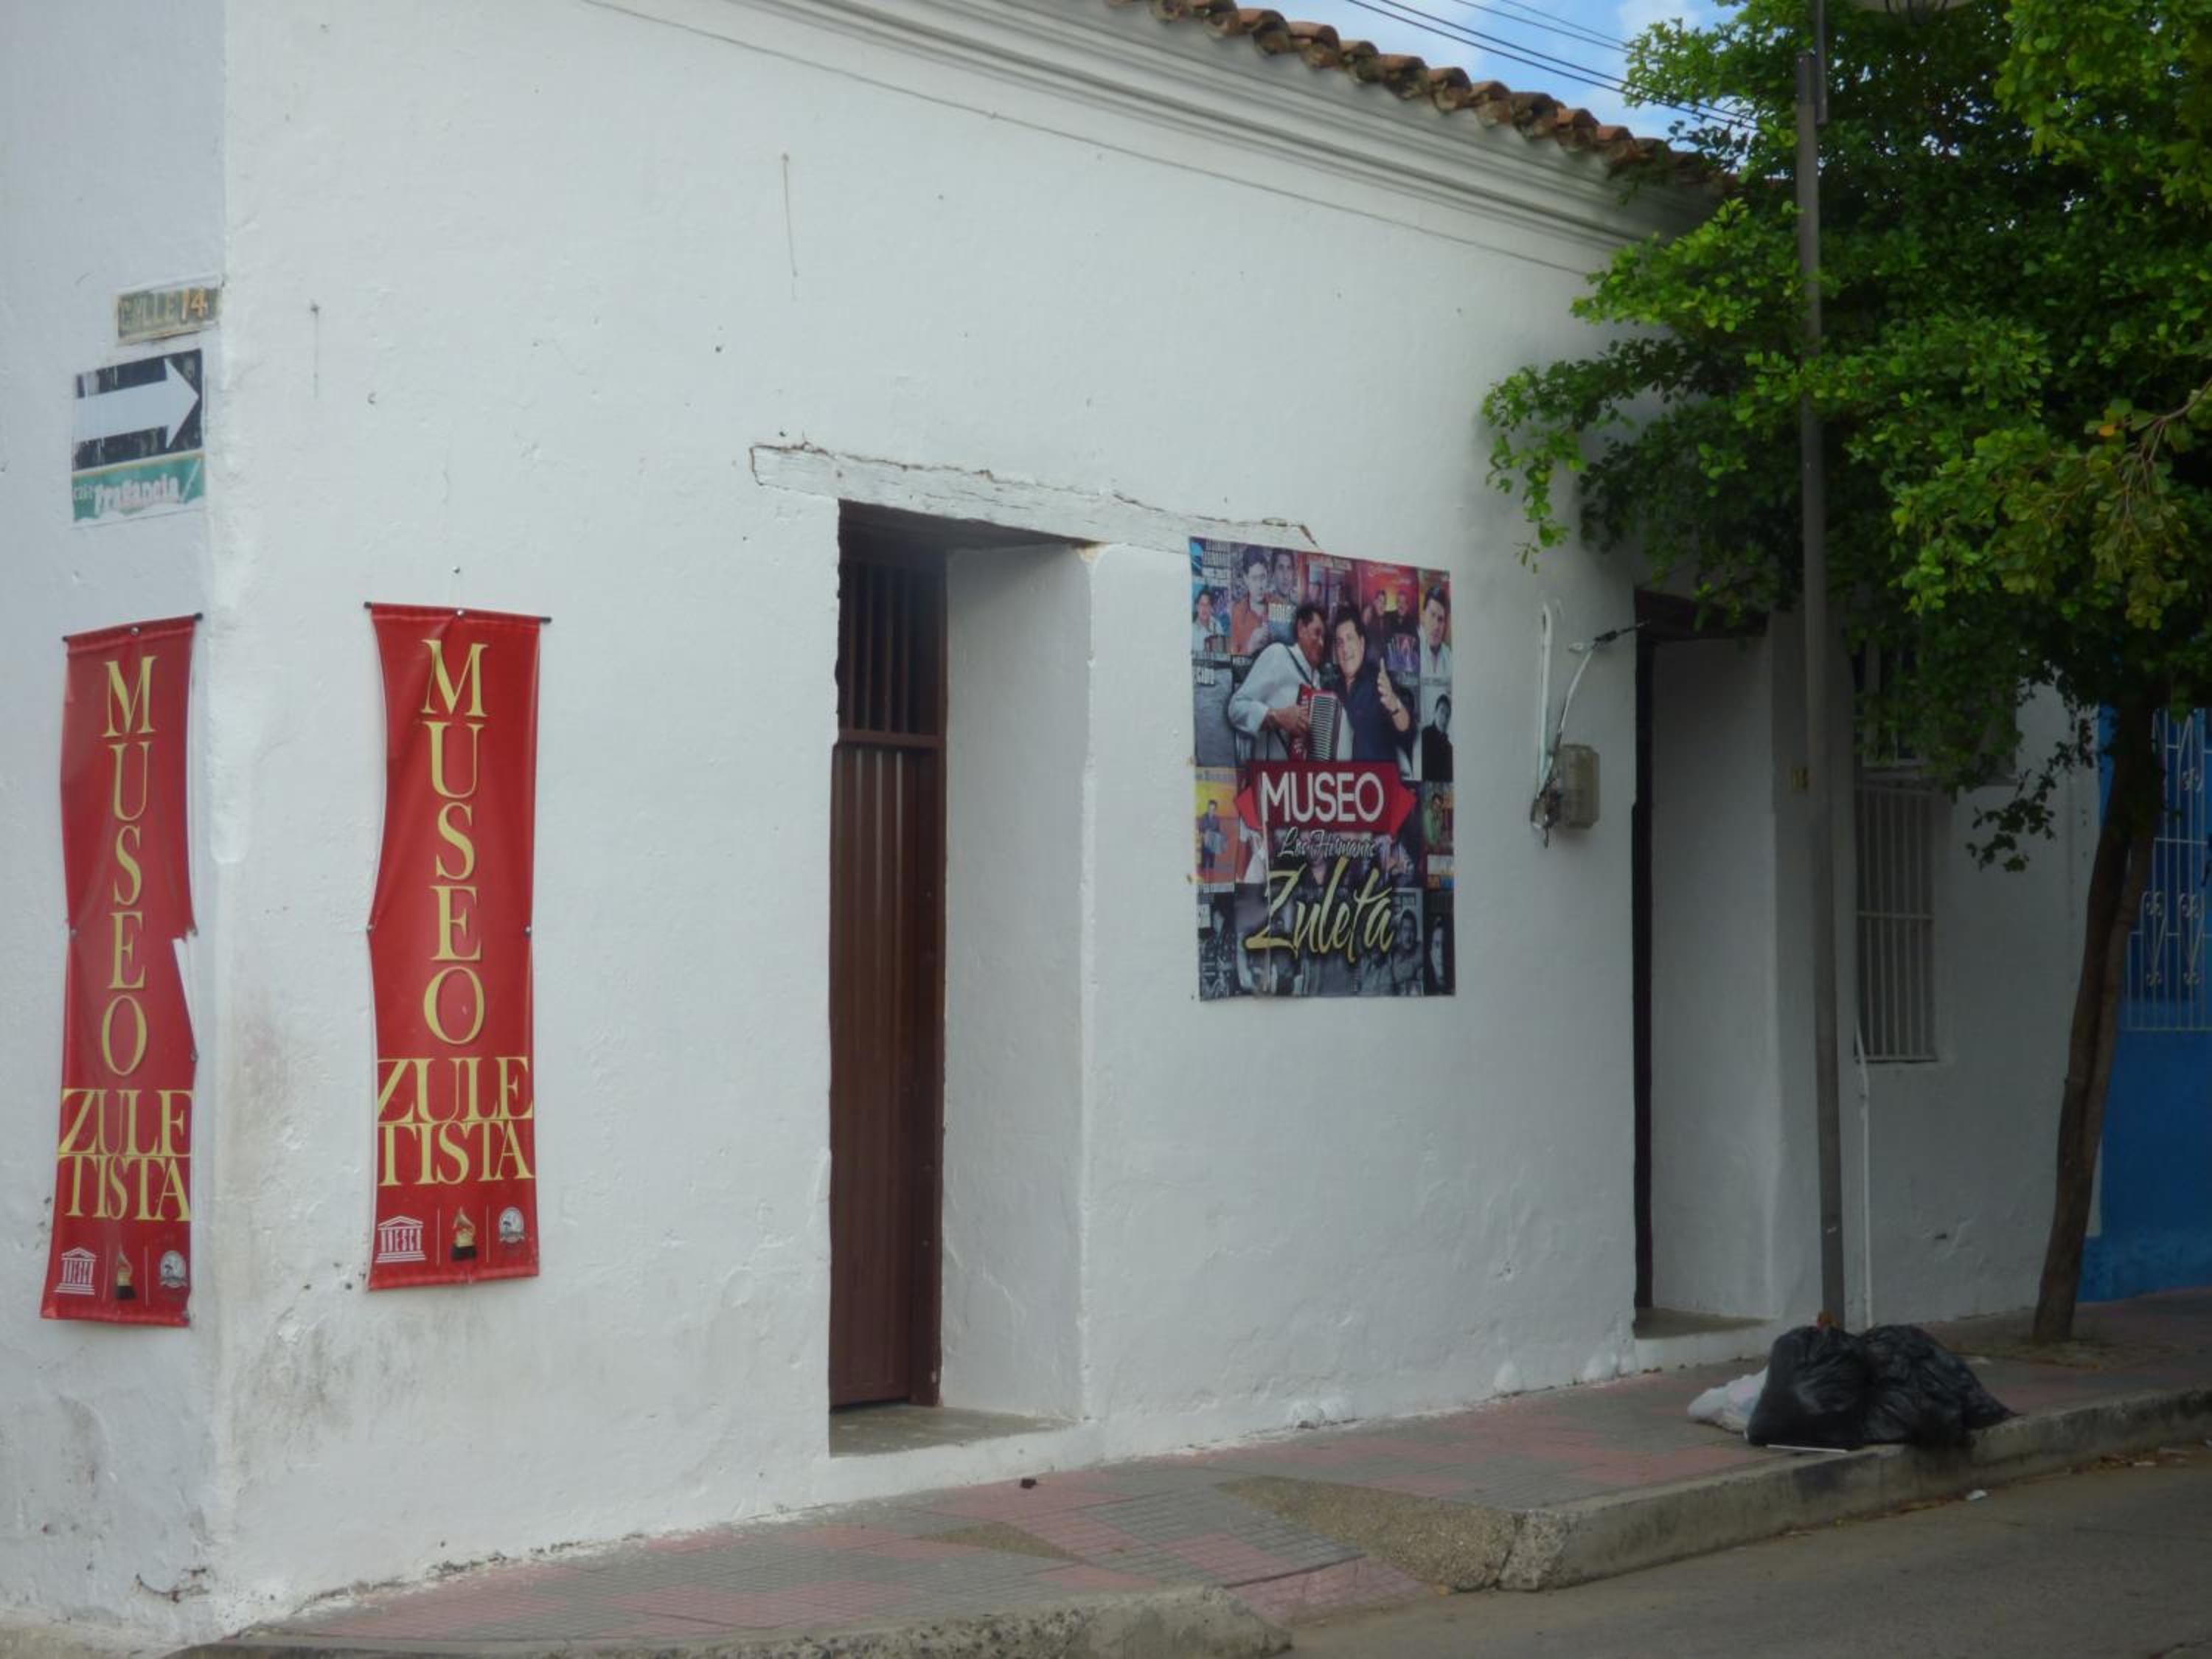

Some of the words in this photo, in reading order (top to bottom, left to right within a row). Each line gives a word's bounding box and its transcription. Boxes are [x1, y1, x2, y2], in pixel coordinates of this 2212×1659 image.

[181, 286, 209, 321] 14
[1260, 771, 1385, 824] MUSEO
[101, 655, 158, 1077] MUSEO
[420, 638, 490, 1046] MUSEO
[1245, 855, 1397, 964] Zuleta
[58, 1088, 194, 1158] ZULE
[377, 1056, 534, 1124] ZULE
[377, 1119, 535, 1186] TISTA
[57, 1153, 192, 1222] TISTA
